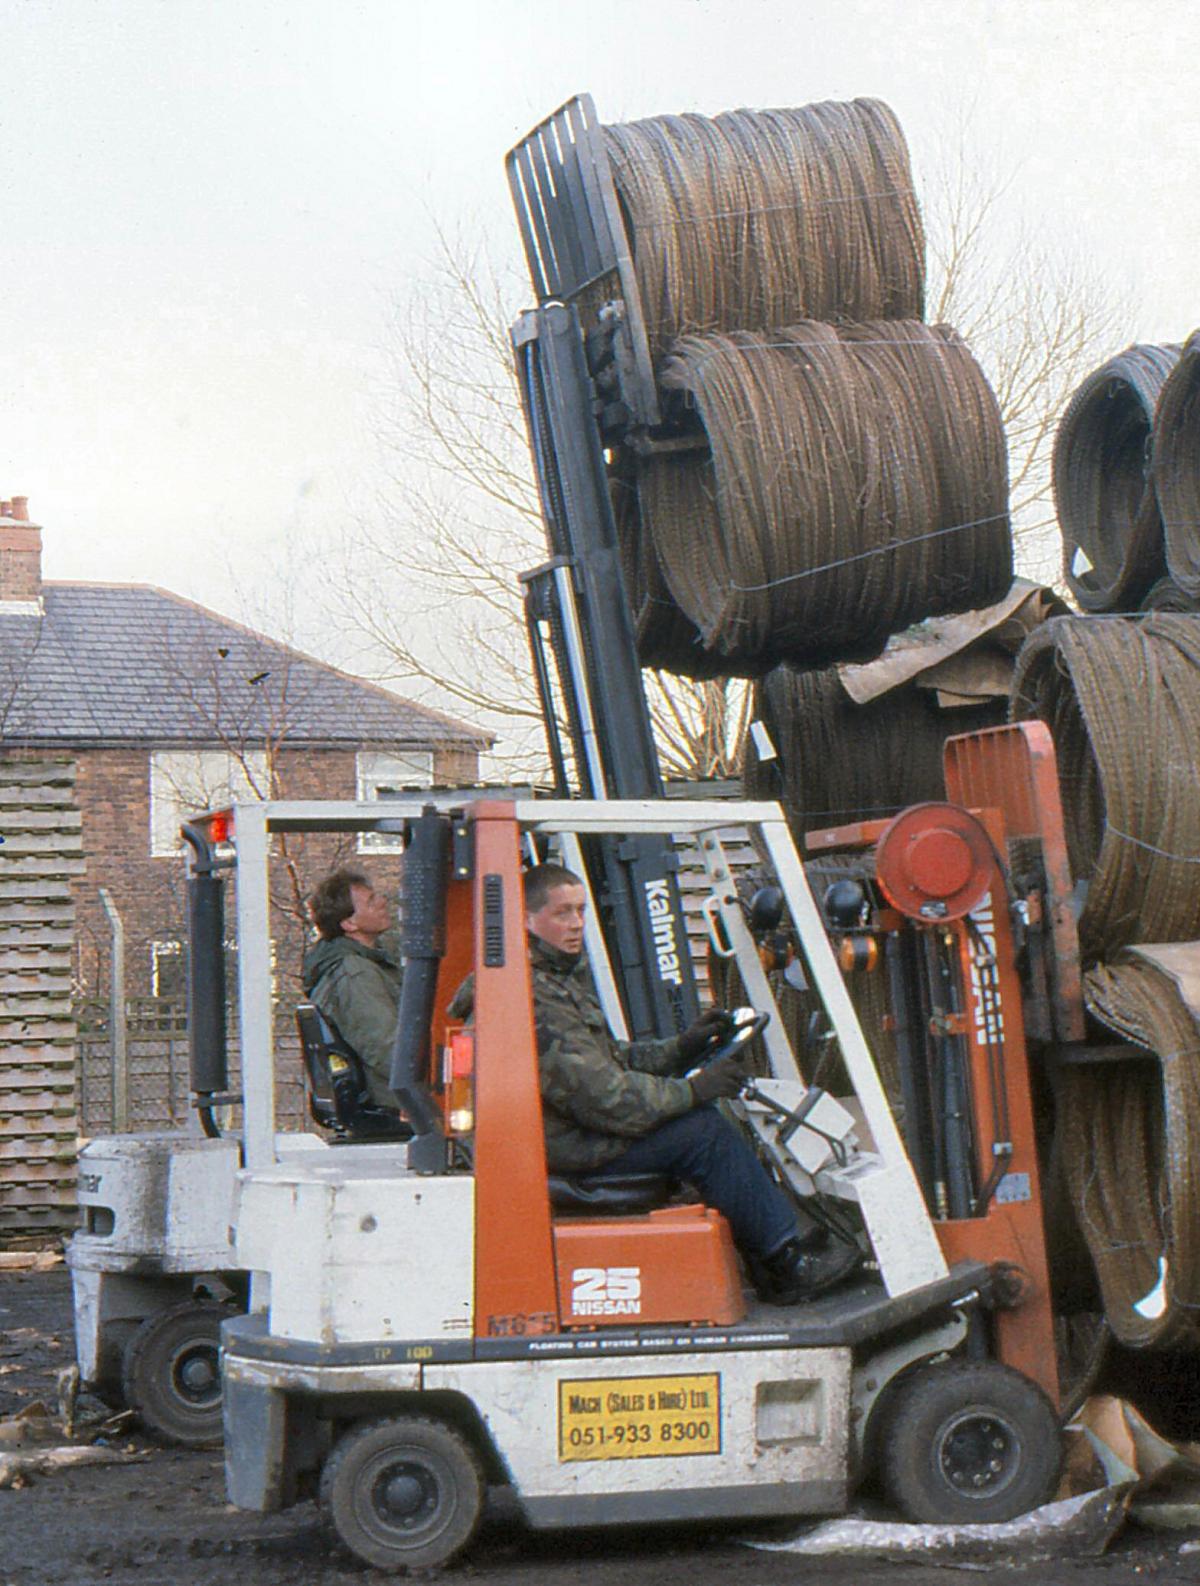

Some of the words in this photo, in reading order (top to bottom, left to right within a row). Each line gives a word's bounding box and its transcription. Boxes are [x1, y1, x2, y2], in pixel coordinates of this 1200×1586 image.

[644, 878, 683, 985] Kalmar
[572, 1267, 641, 1300] 25
[572, 1300, 641, 1316] NISSAN
[529, 1341, 574, 1350] FLOATING
[642, 1338, 673, 1347] BASED
[569, 1394, 601, 1414] MACH
[607, 1391, 644, 1414] (SALES
[648, 1393, 656, 1410] &
[570, 1424, 652, 1446] 051-933
[660, 1421, 711, 1442] 8300
